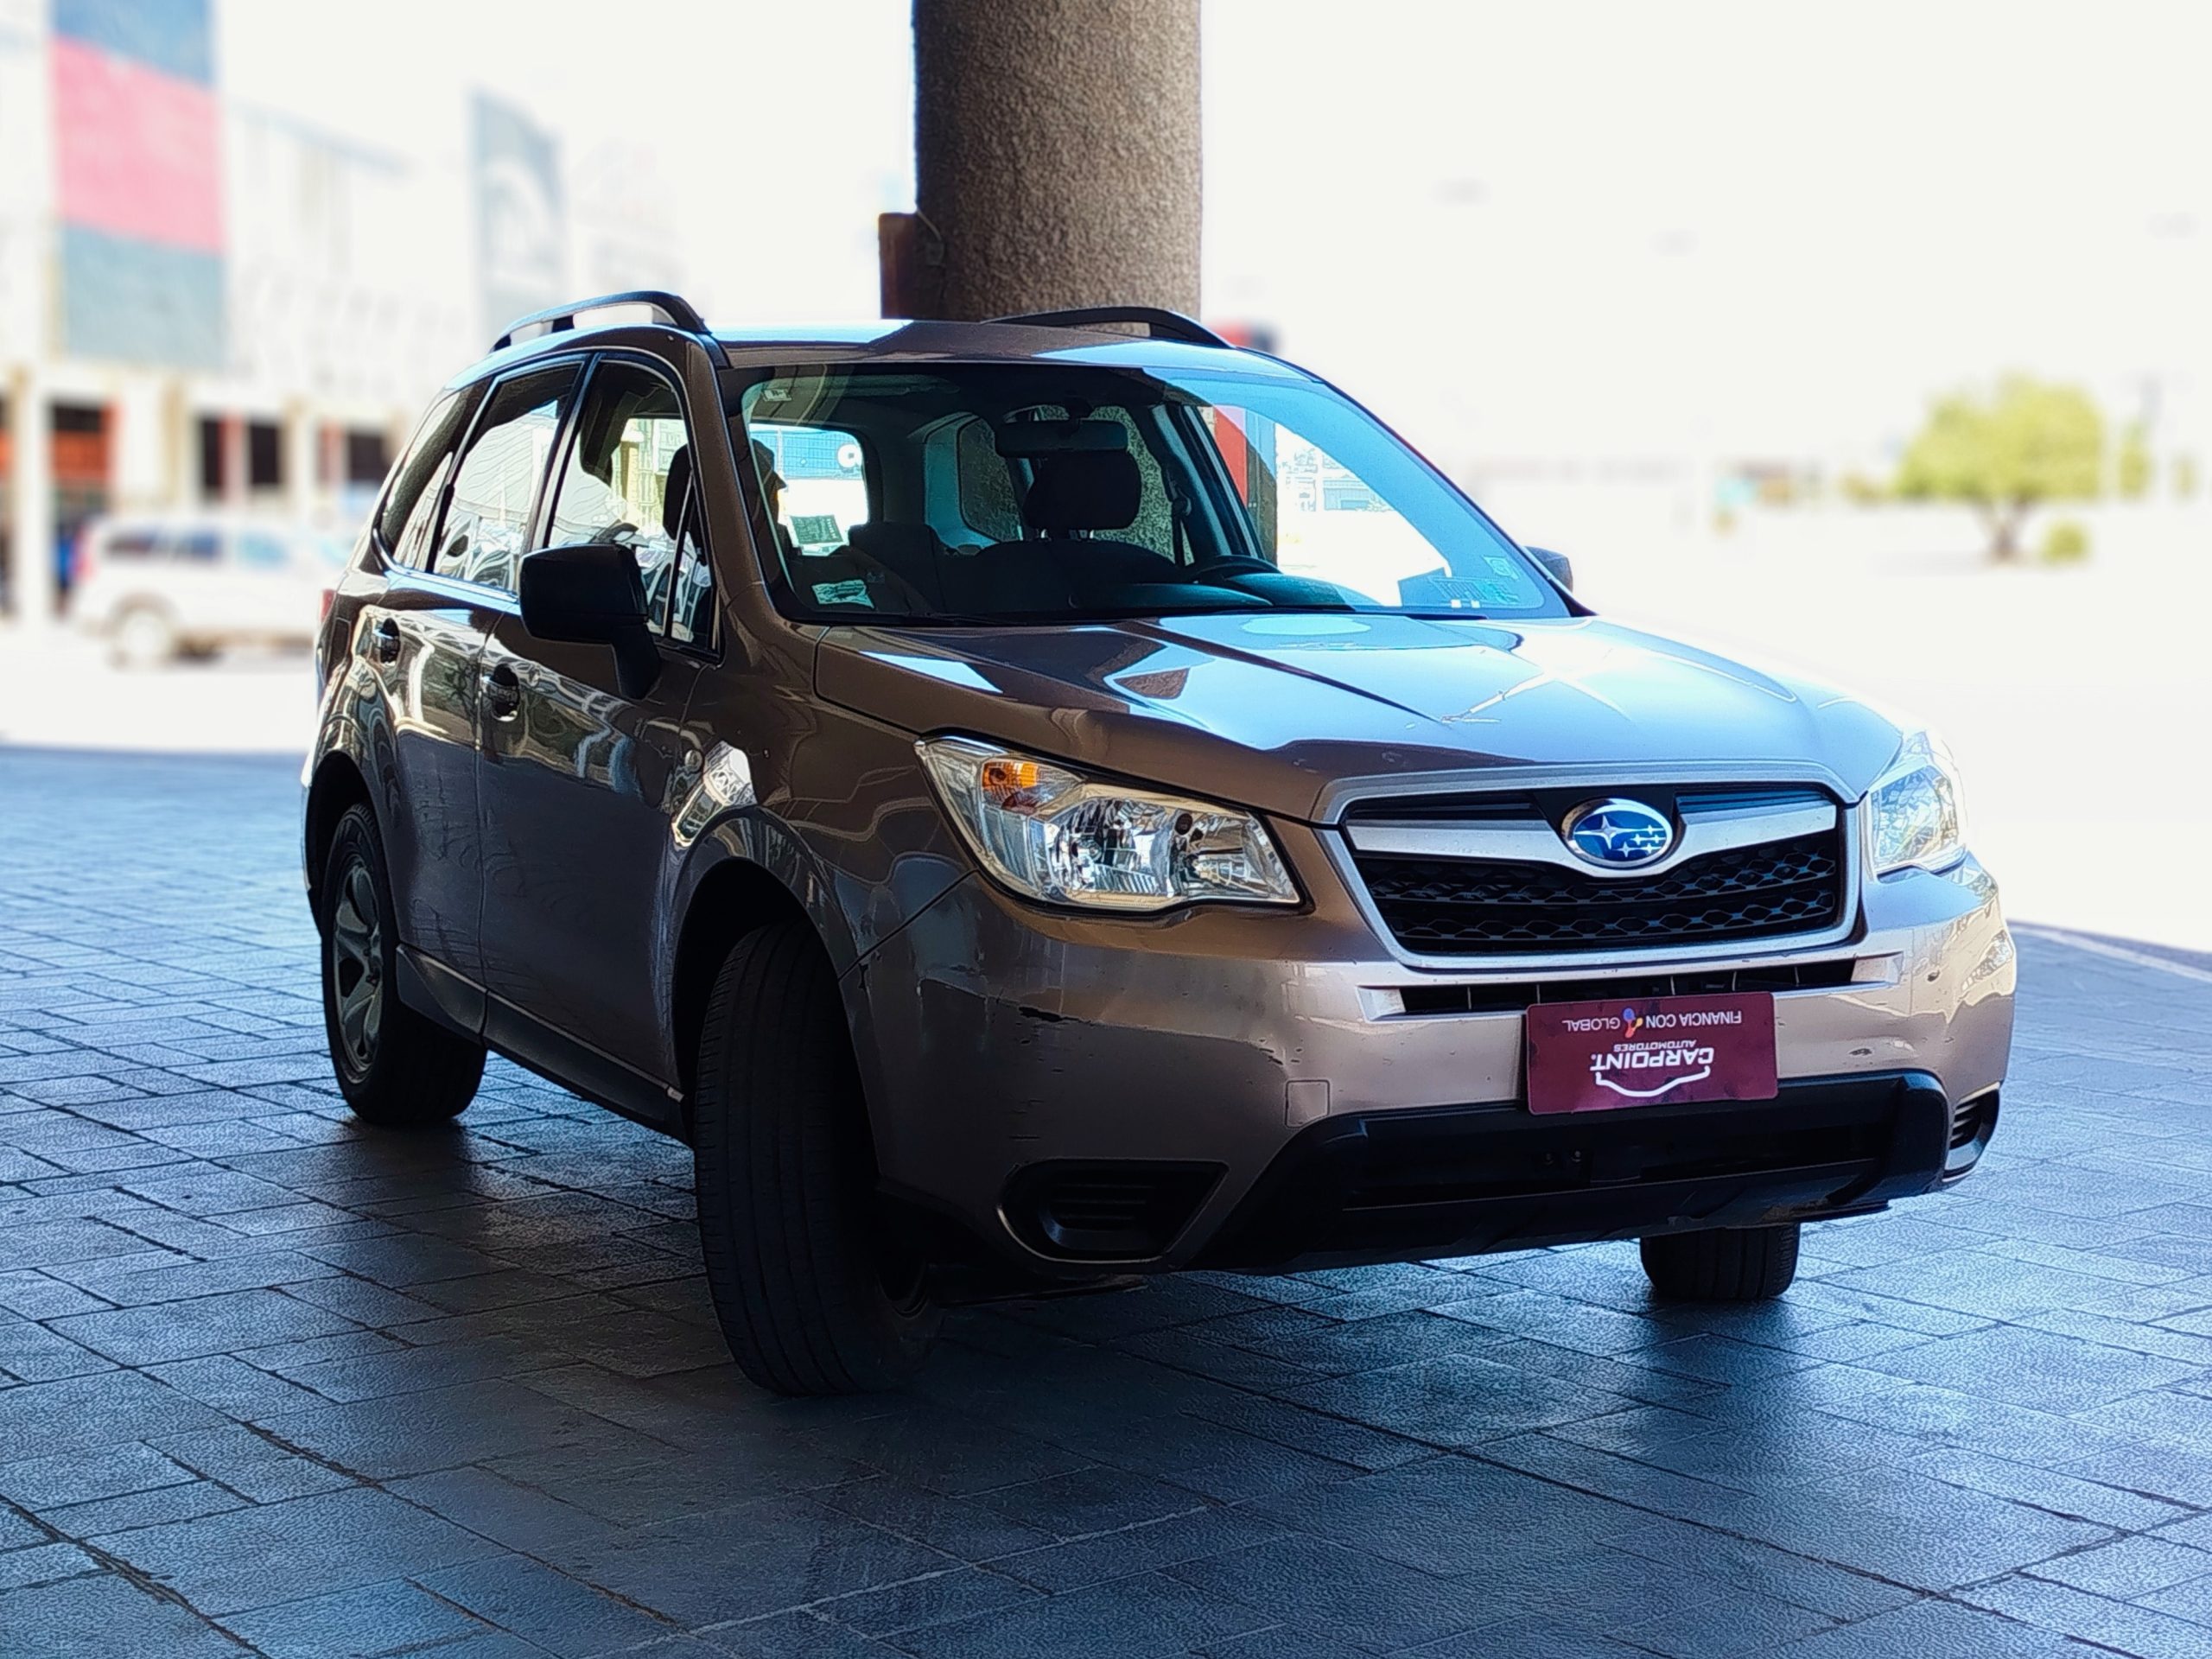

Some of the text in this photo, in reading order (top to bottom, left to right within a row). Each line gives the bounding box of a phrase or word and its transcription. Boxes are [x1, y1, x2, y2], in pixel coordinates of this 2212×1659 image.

[1562, 1011, 1741, 1032] FINANCIA CON GLOBAL
[1614, 1039, 1696, 1052] AUTOMOTORES
